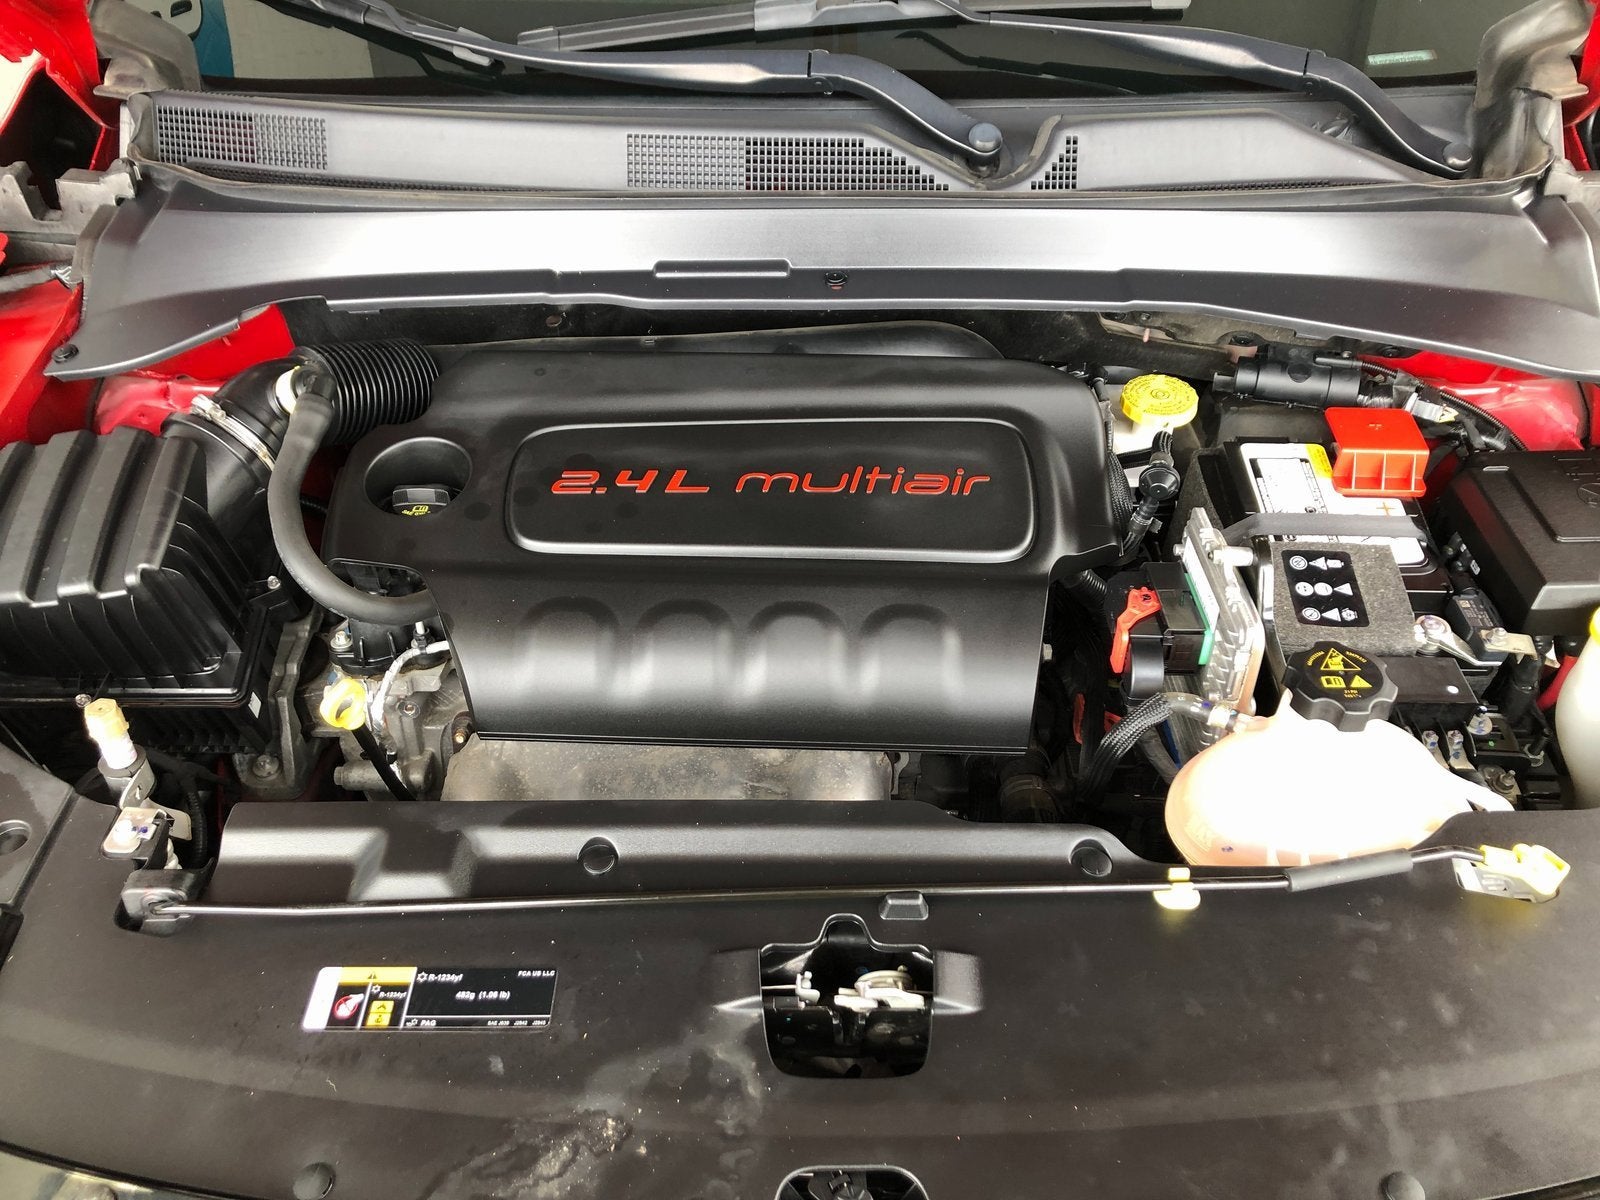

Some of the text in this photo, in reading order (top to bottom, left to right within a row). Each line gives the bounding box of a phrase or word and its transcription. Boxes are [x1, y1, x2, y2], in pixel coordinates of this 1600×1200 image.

[551, 466, 991, 495] 2.4L multiair
[428, 973, 463, 984] R-1234yf
[379, 991, 407, 999] R-1234yf
[499, 991, 511, 1000] lb)
